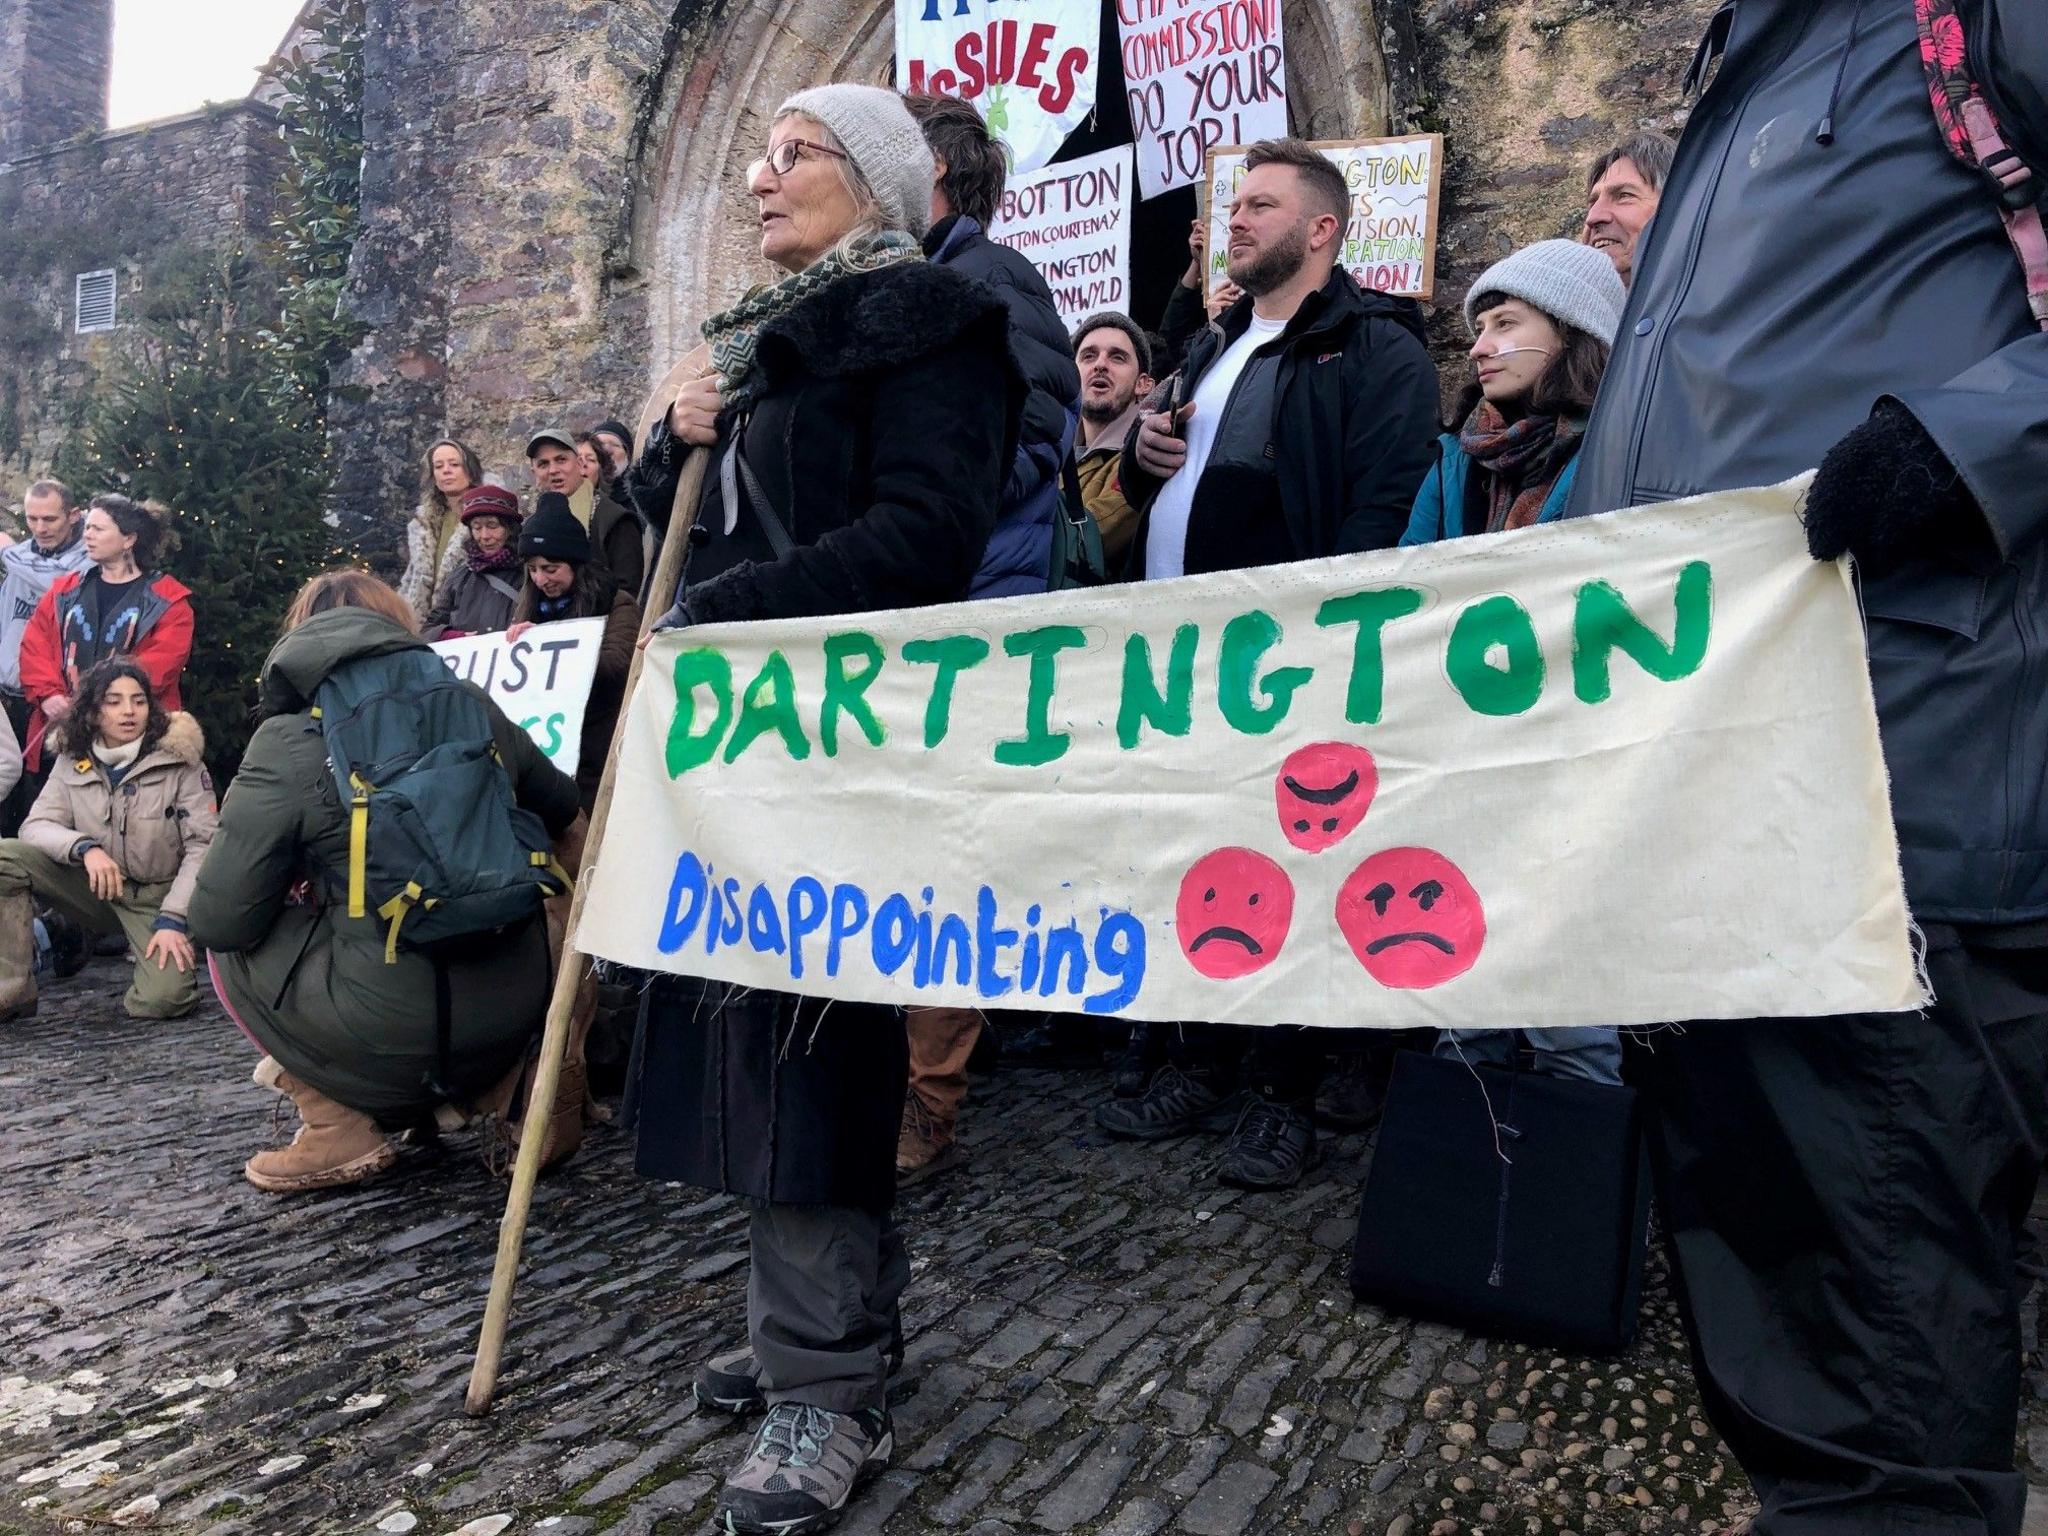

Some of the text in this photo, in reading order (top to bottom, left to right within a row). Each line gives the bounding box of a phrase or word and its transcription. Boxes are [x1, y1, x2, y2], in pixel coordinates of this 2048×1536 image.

[1122, 0, 1277, 81] COMMISSION!
[1128, 44, 1285, 142] DO YOUR
[1001, 162, 1121, 224] BOTTON
[664, 559, 1713, 780] DARTINGTON
[657, 849, 1147, 1014] Disappointing
